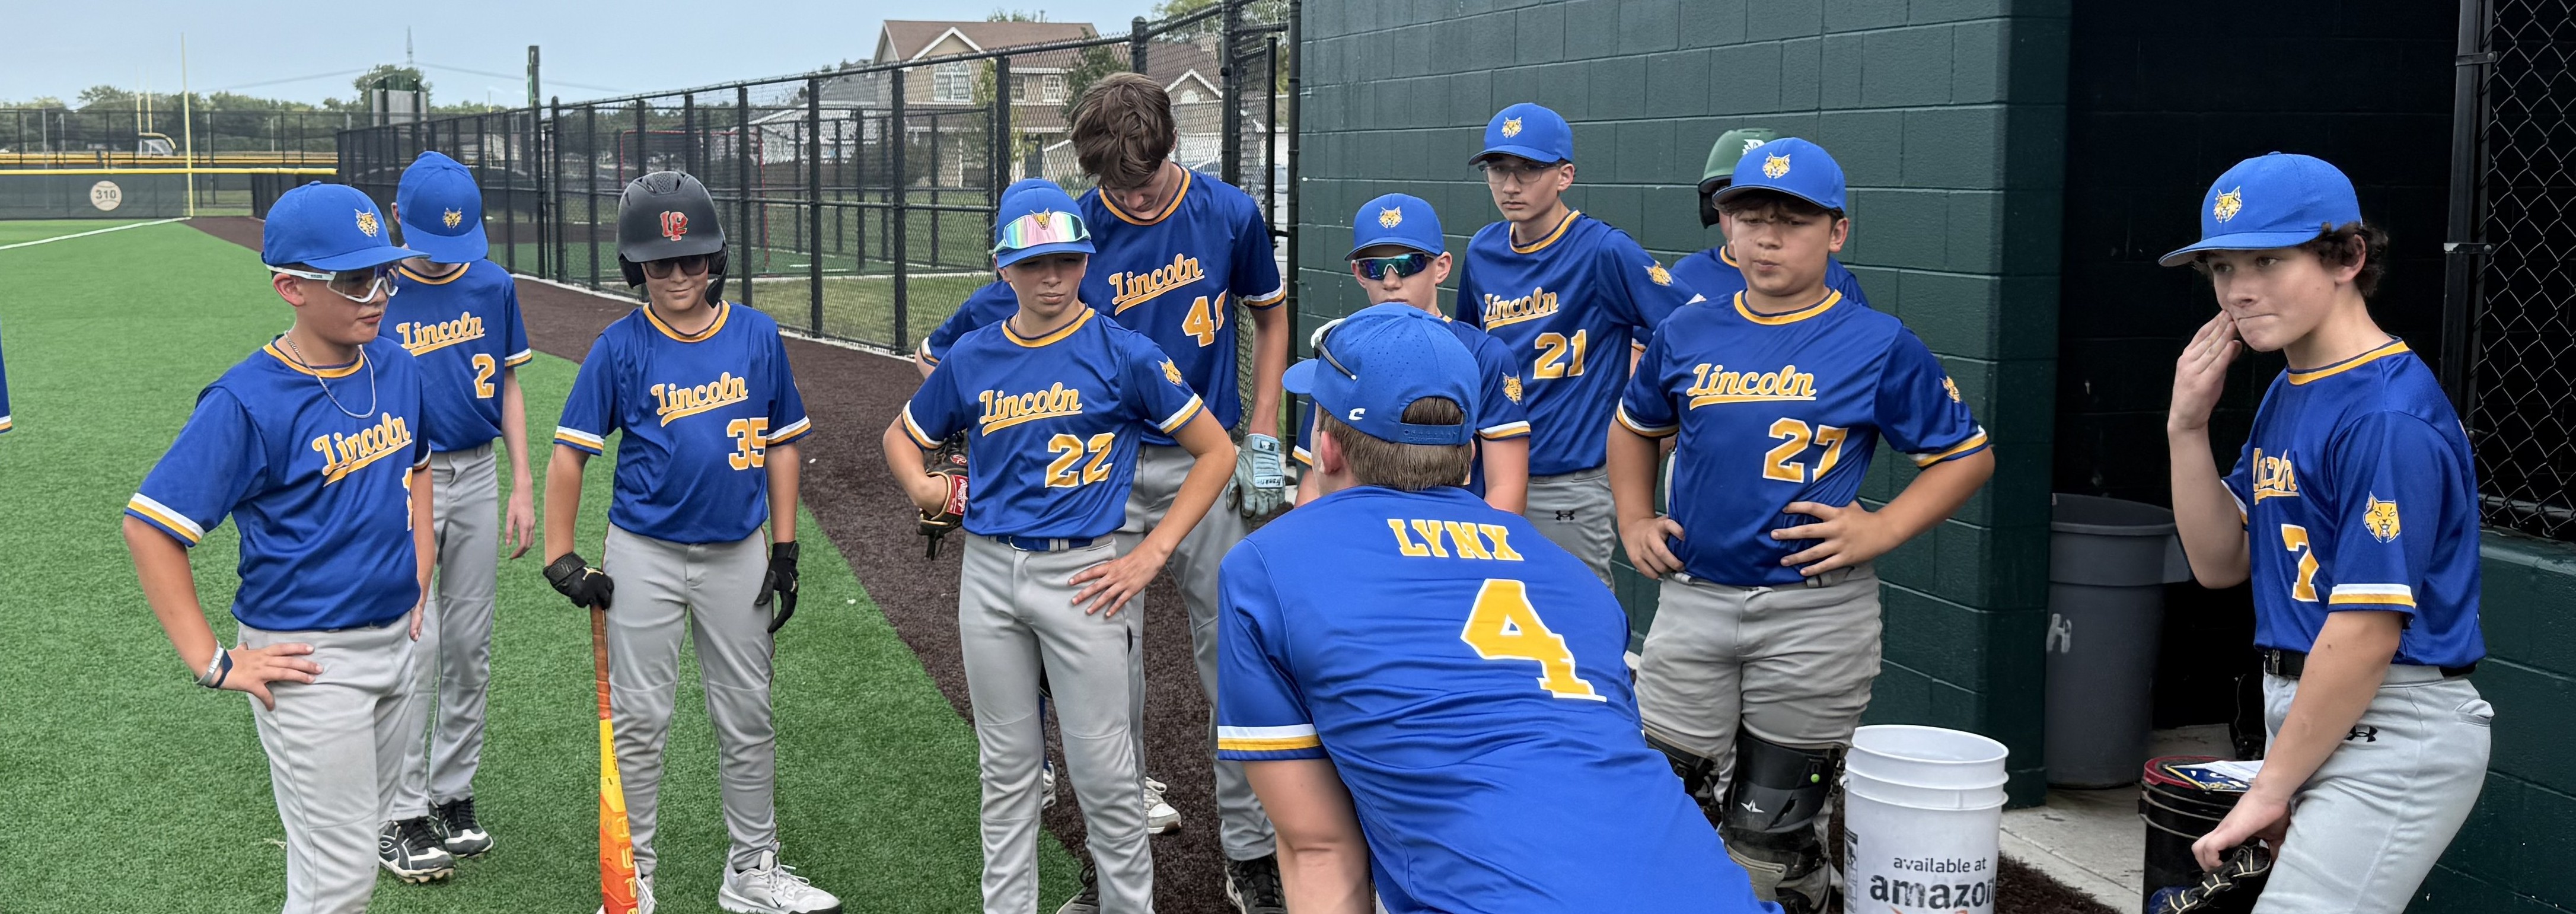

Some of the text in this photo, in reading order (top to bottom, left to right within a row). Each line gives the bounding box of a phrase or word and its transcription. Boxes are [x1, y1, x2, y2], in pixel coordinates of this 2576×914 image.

[95, 189, 117, 199] 310
[1108, 253, 1204, 305] Lincoln
[1484, 286, 1560, 323] Lincoln
[396, 311, 485, 350] Lincoln
[472, 353, 496, 399] 2
[1532, 329, 1587, 380] 21
[650, 371, 749, 416] Lincoln
[978, 381, 1083, 424] Lincoln
[1686, 363, 1817, 397] Lincoln
[311, 412, 411, 476] Lincoln
[726, 416, 769, 470] 35
[1045, 432, 1115, 488] 22
[1762, 417, 1850, 483] 27
[1386, 518, 1525, 561] LYNX
[2281, 523, 2320, 603] 7
[1460, 578, 1608, 703] 4
[1893, 857, 1987, 873] available at
[1869, 874, 1995, 909] amazon
